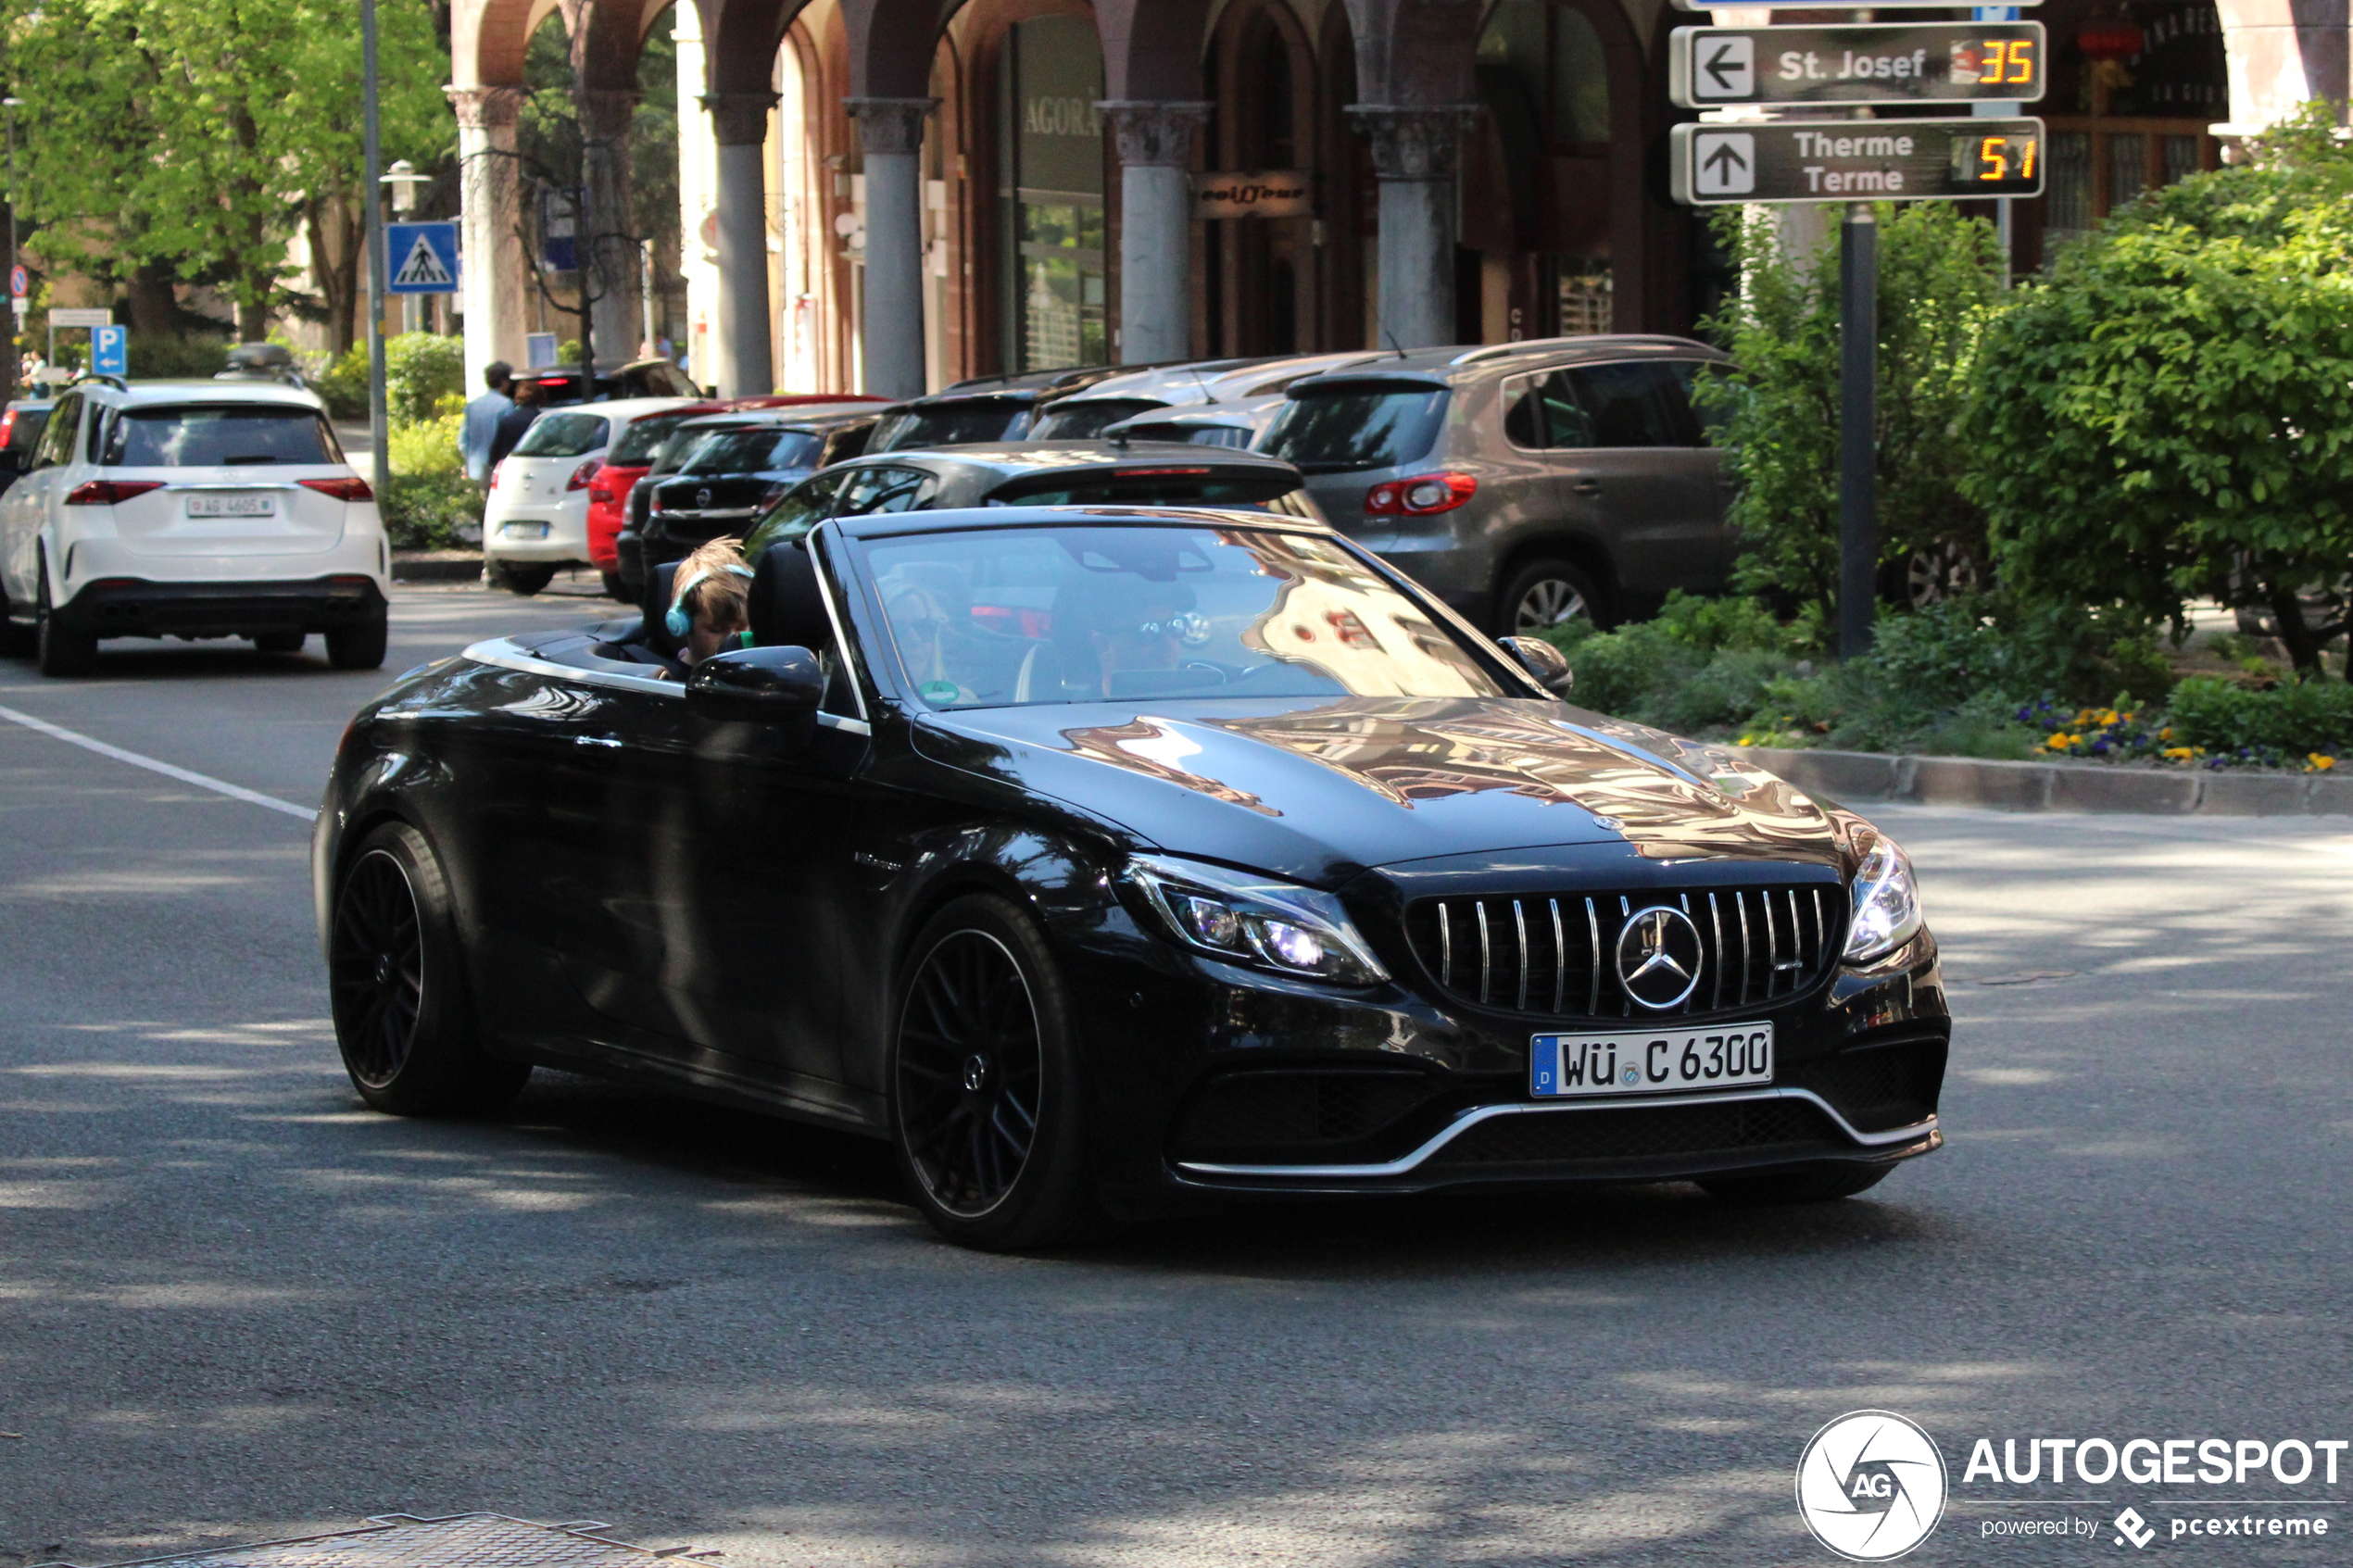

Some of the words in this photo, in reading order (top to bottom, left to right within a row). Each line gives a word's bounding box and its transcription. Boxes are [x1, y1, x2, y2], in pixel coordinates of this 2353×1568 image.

[1779, 51, 1827, 81] St.
[1836, 48, 1927, 79] Josef
[1979, 40, 2033, 83] 35
[1793, 132, 1915, 158] Therme
[1979, 137, 2036, 181] 51
[1803, 167, 1905, 193] Terme
[99, 329, 118, 353] P
[1563, 1043, 1617, 1087] WÜ
[1646, 1040, 1669, 1083] C
[1680, 1032, 1768, 1081] 6300
[1540, 1072, 1550, 1085] D
